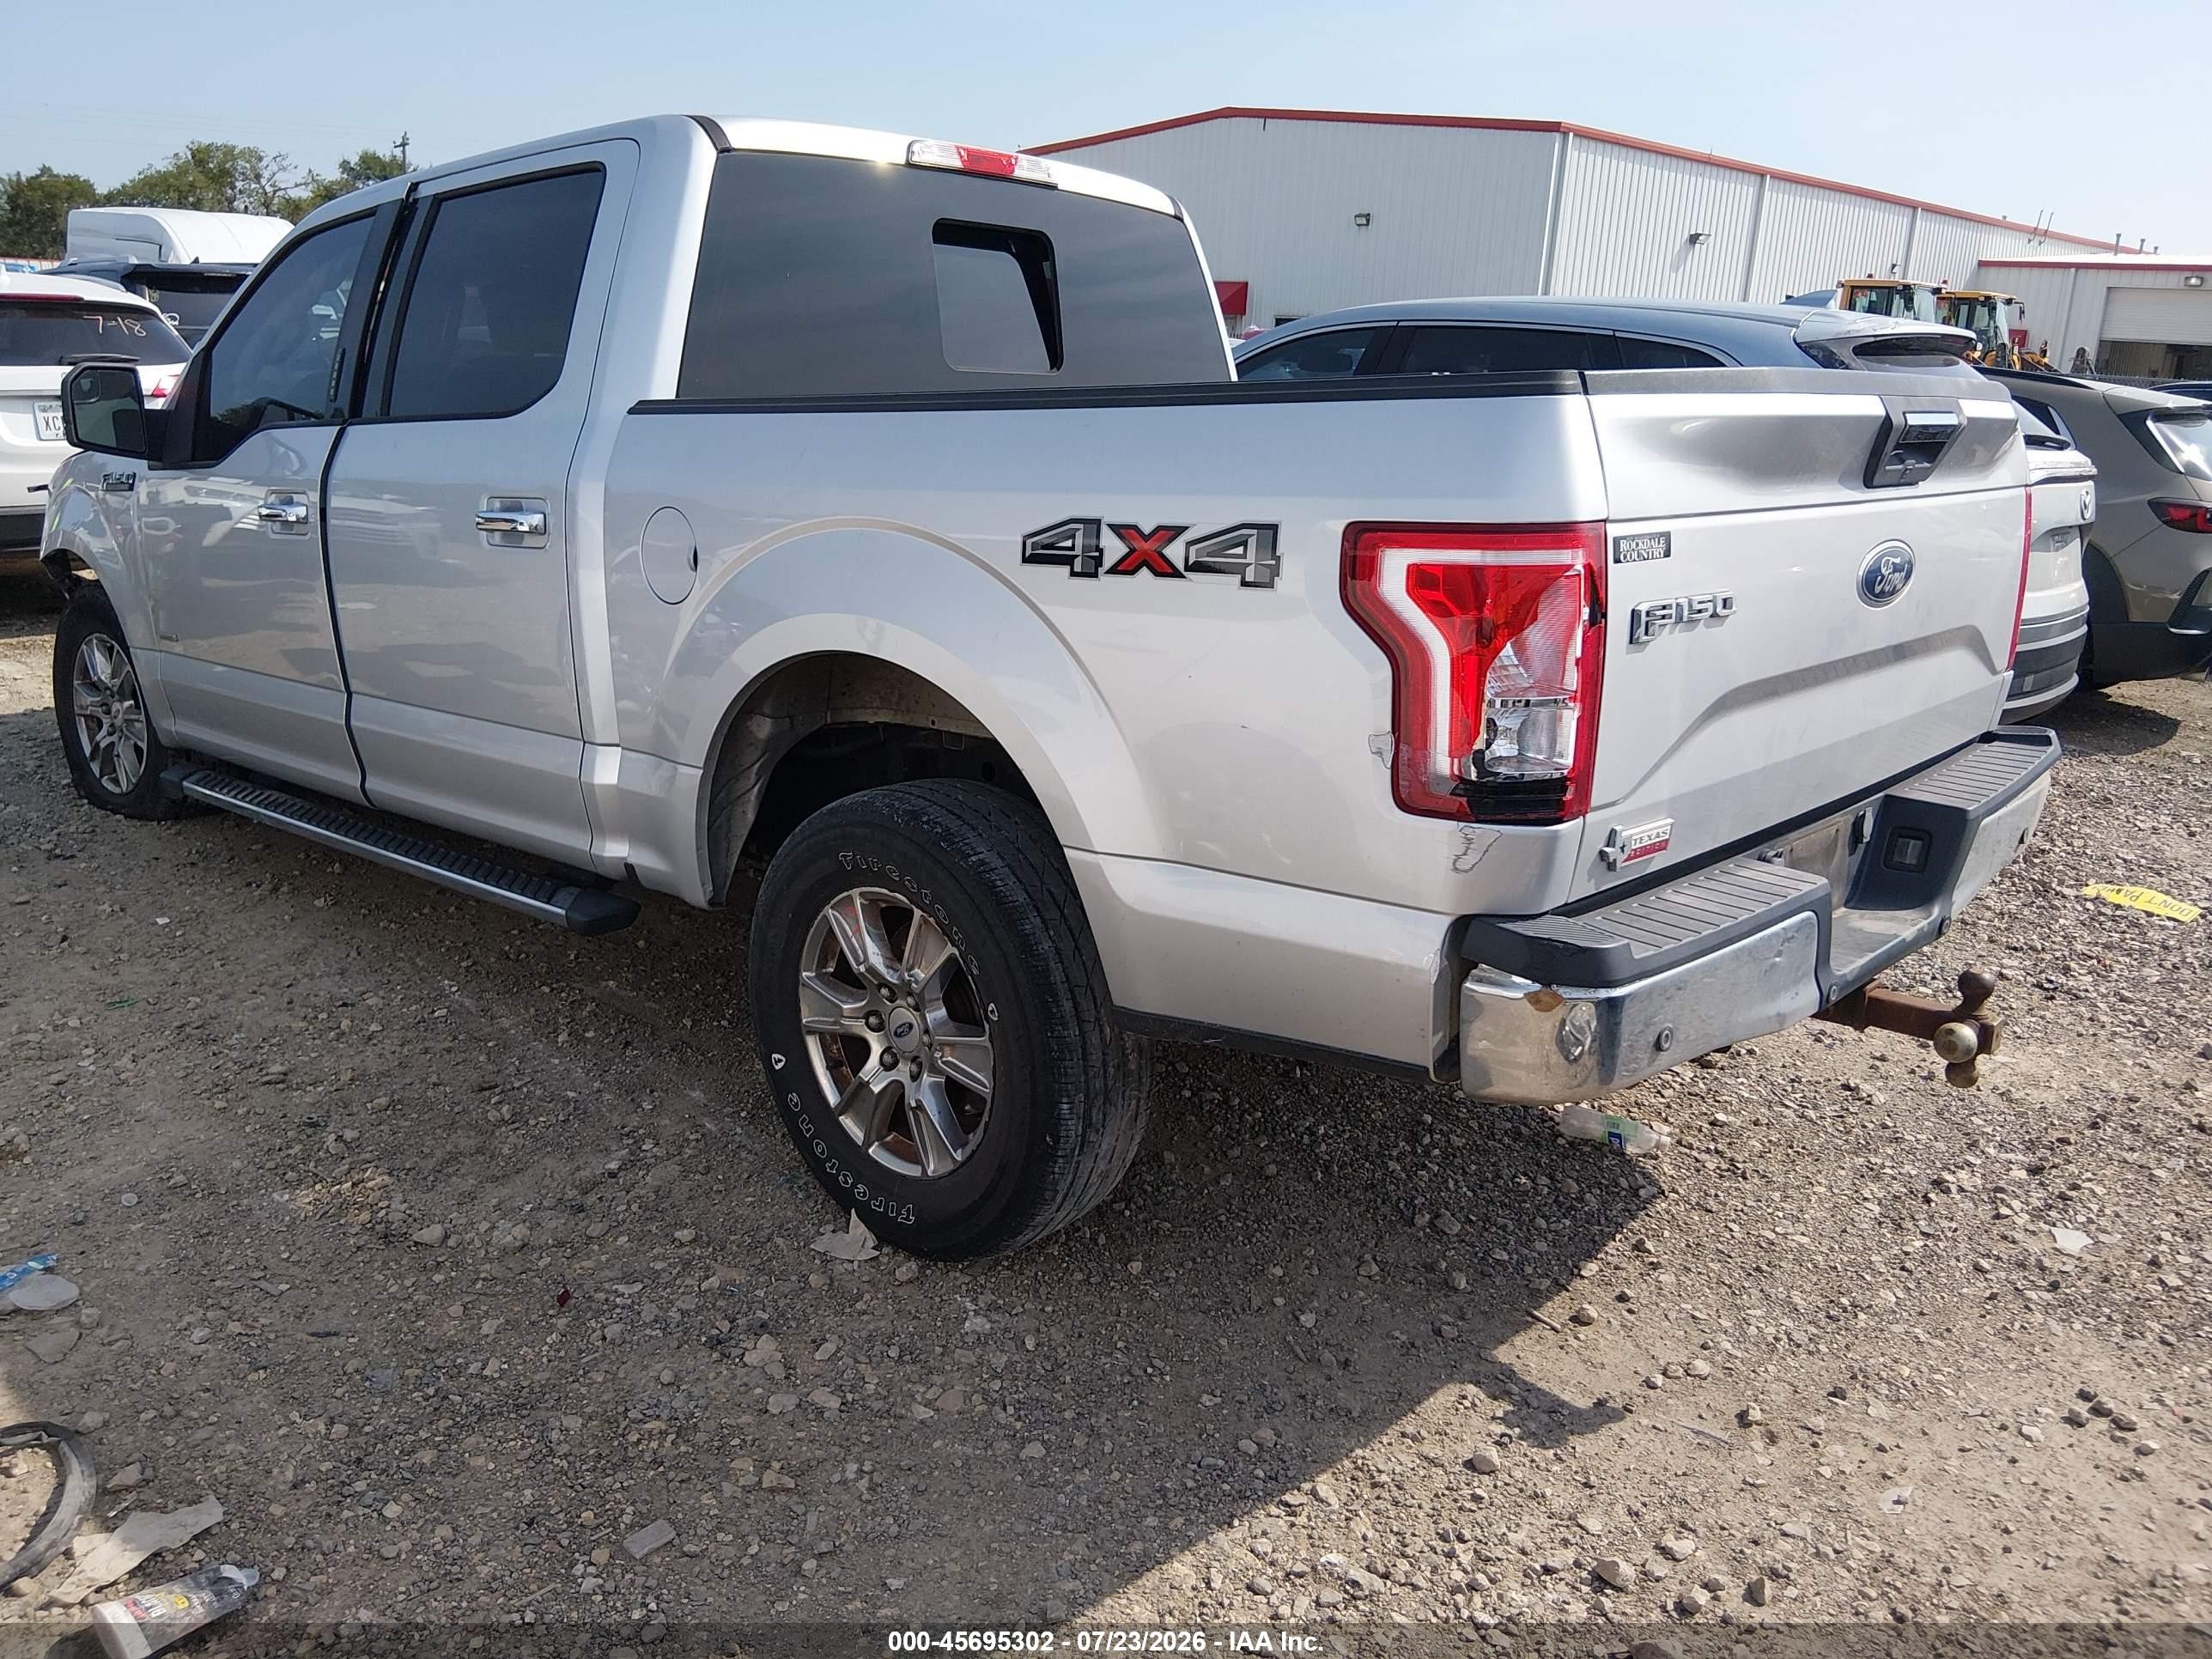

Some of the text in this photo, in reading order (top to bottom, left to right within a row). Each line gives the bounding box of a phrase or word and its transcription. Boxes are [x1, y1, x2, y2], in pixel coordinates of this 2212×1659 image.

[82, 315, 147, 337] 7-18
[1620, 537, 1666, 552] ROCKDALE
[1620, 547, 1666, 562] COUNTRY
[1632, 829, 1669, 847] TEXAS
[838, 851, 981, 976] Firestone
[787, 1092, 915, 1224] Firestone
